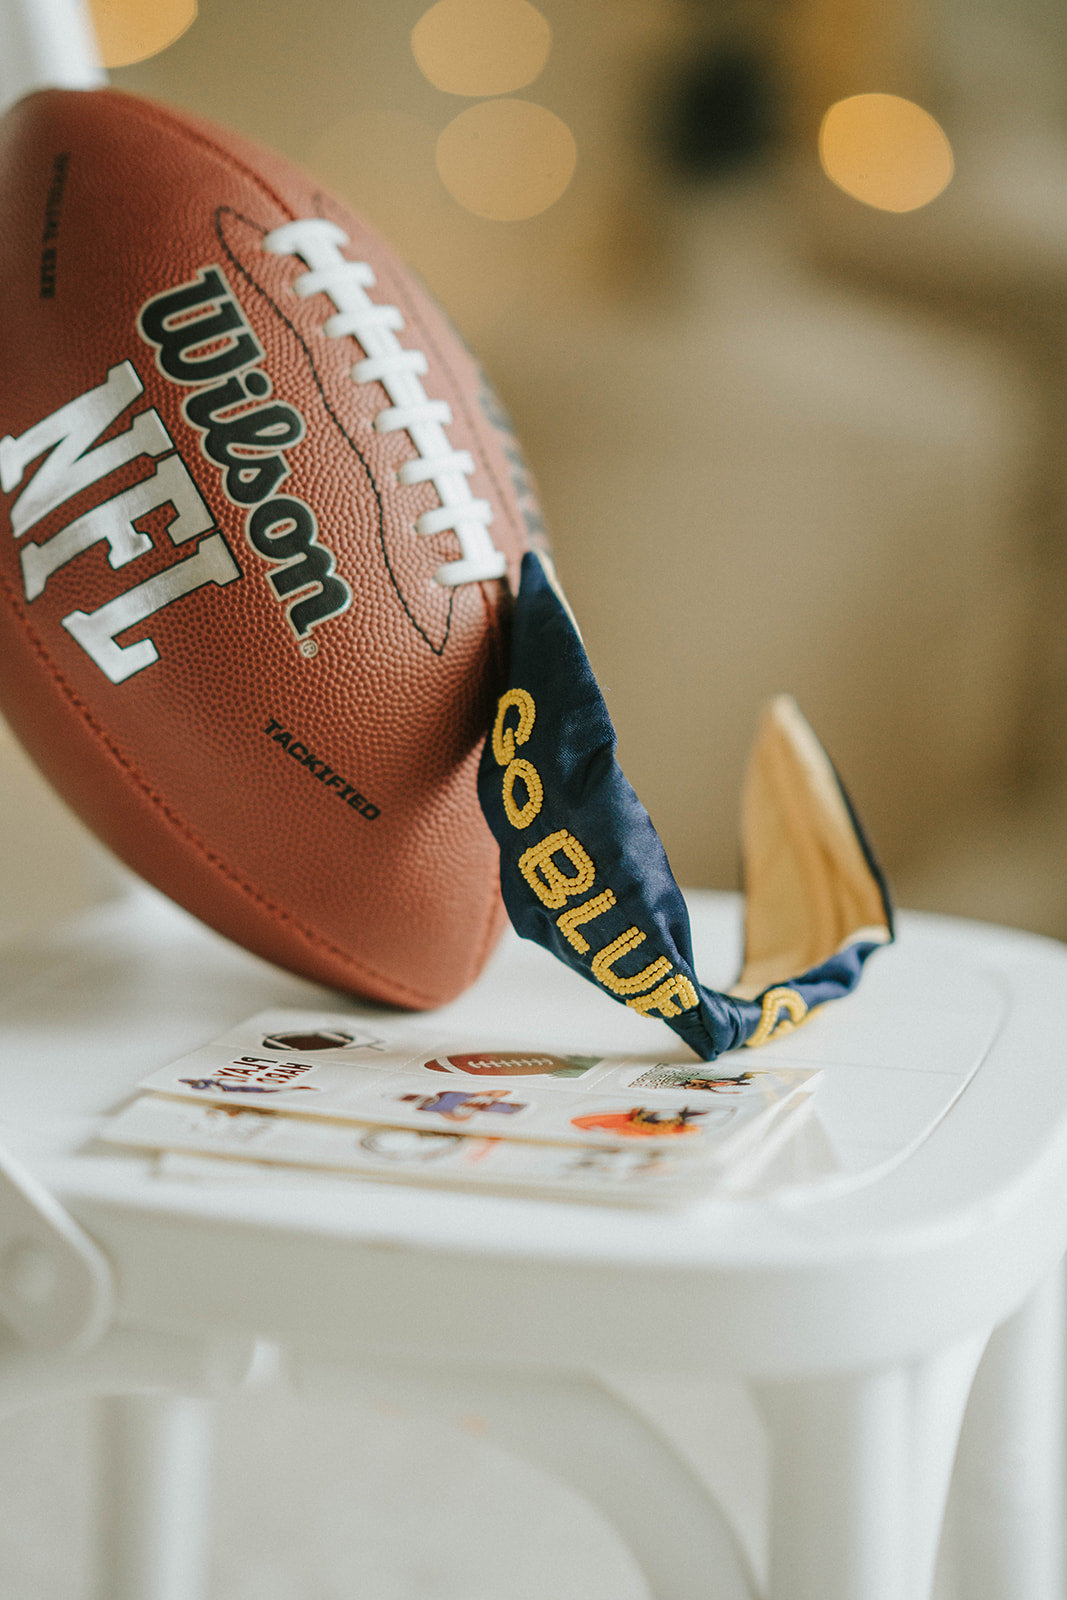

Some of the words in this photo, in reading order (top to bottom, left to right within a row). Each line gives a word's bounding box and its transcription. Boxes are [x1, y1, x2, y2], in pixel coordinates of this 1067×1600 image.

[0, 359, 244, 685] NFL
[136, 264, 353, 641] Wilson
[264, 717, 381, 821] TACKIFIED
[492, 688, 543, 829] GO
